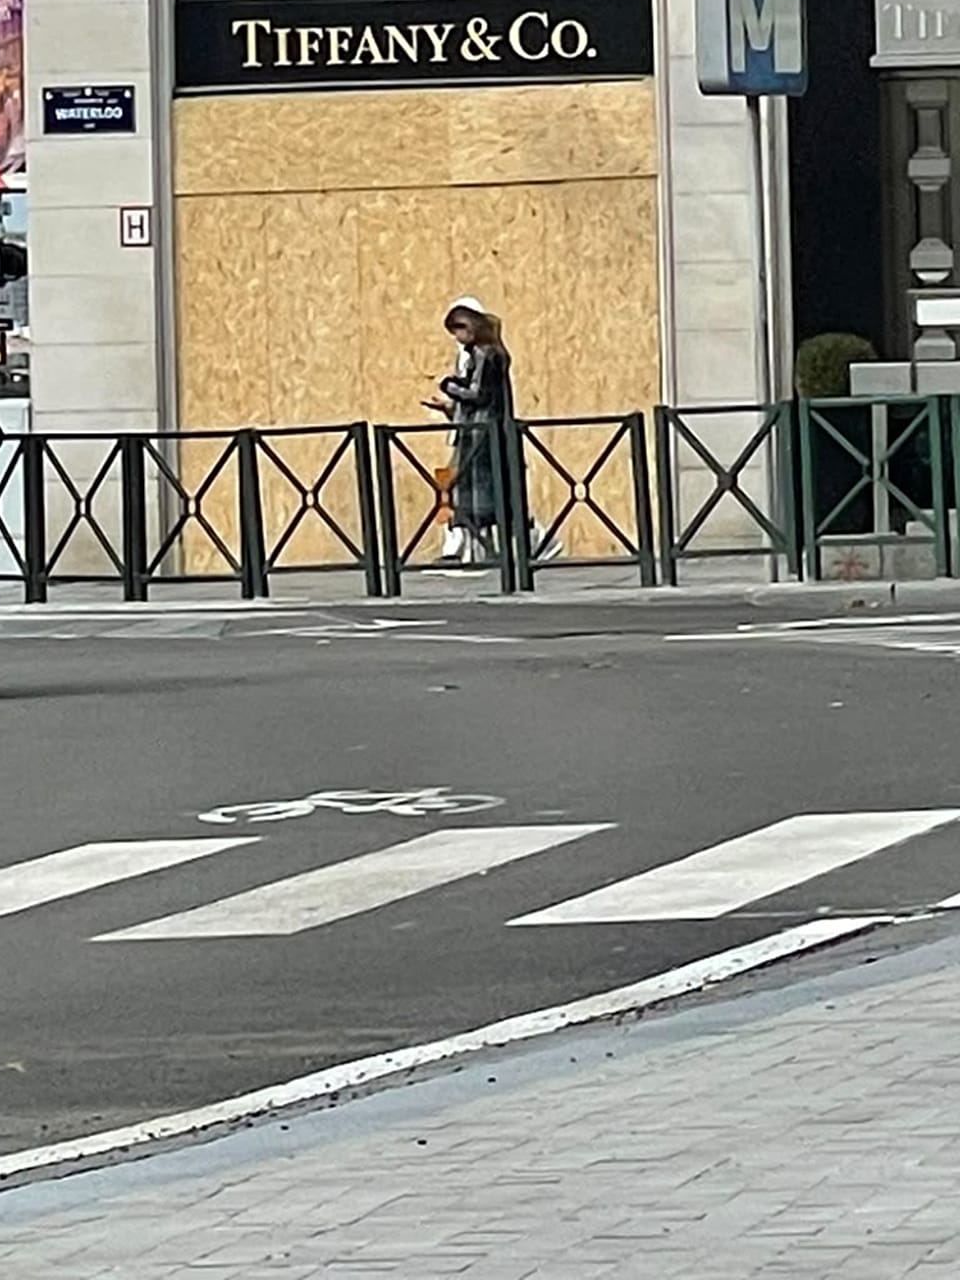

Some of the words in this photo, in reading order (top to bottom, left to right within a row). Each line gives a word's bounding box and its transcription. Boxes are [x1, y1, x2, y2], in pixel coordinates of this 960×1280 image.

[232, 19, 455, 67] TIFFANY
[460, 16, 502, 61] &
[54, 106, 124, 121] WATERLOO
[127, 213, 145, 240] H
